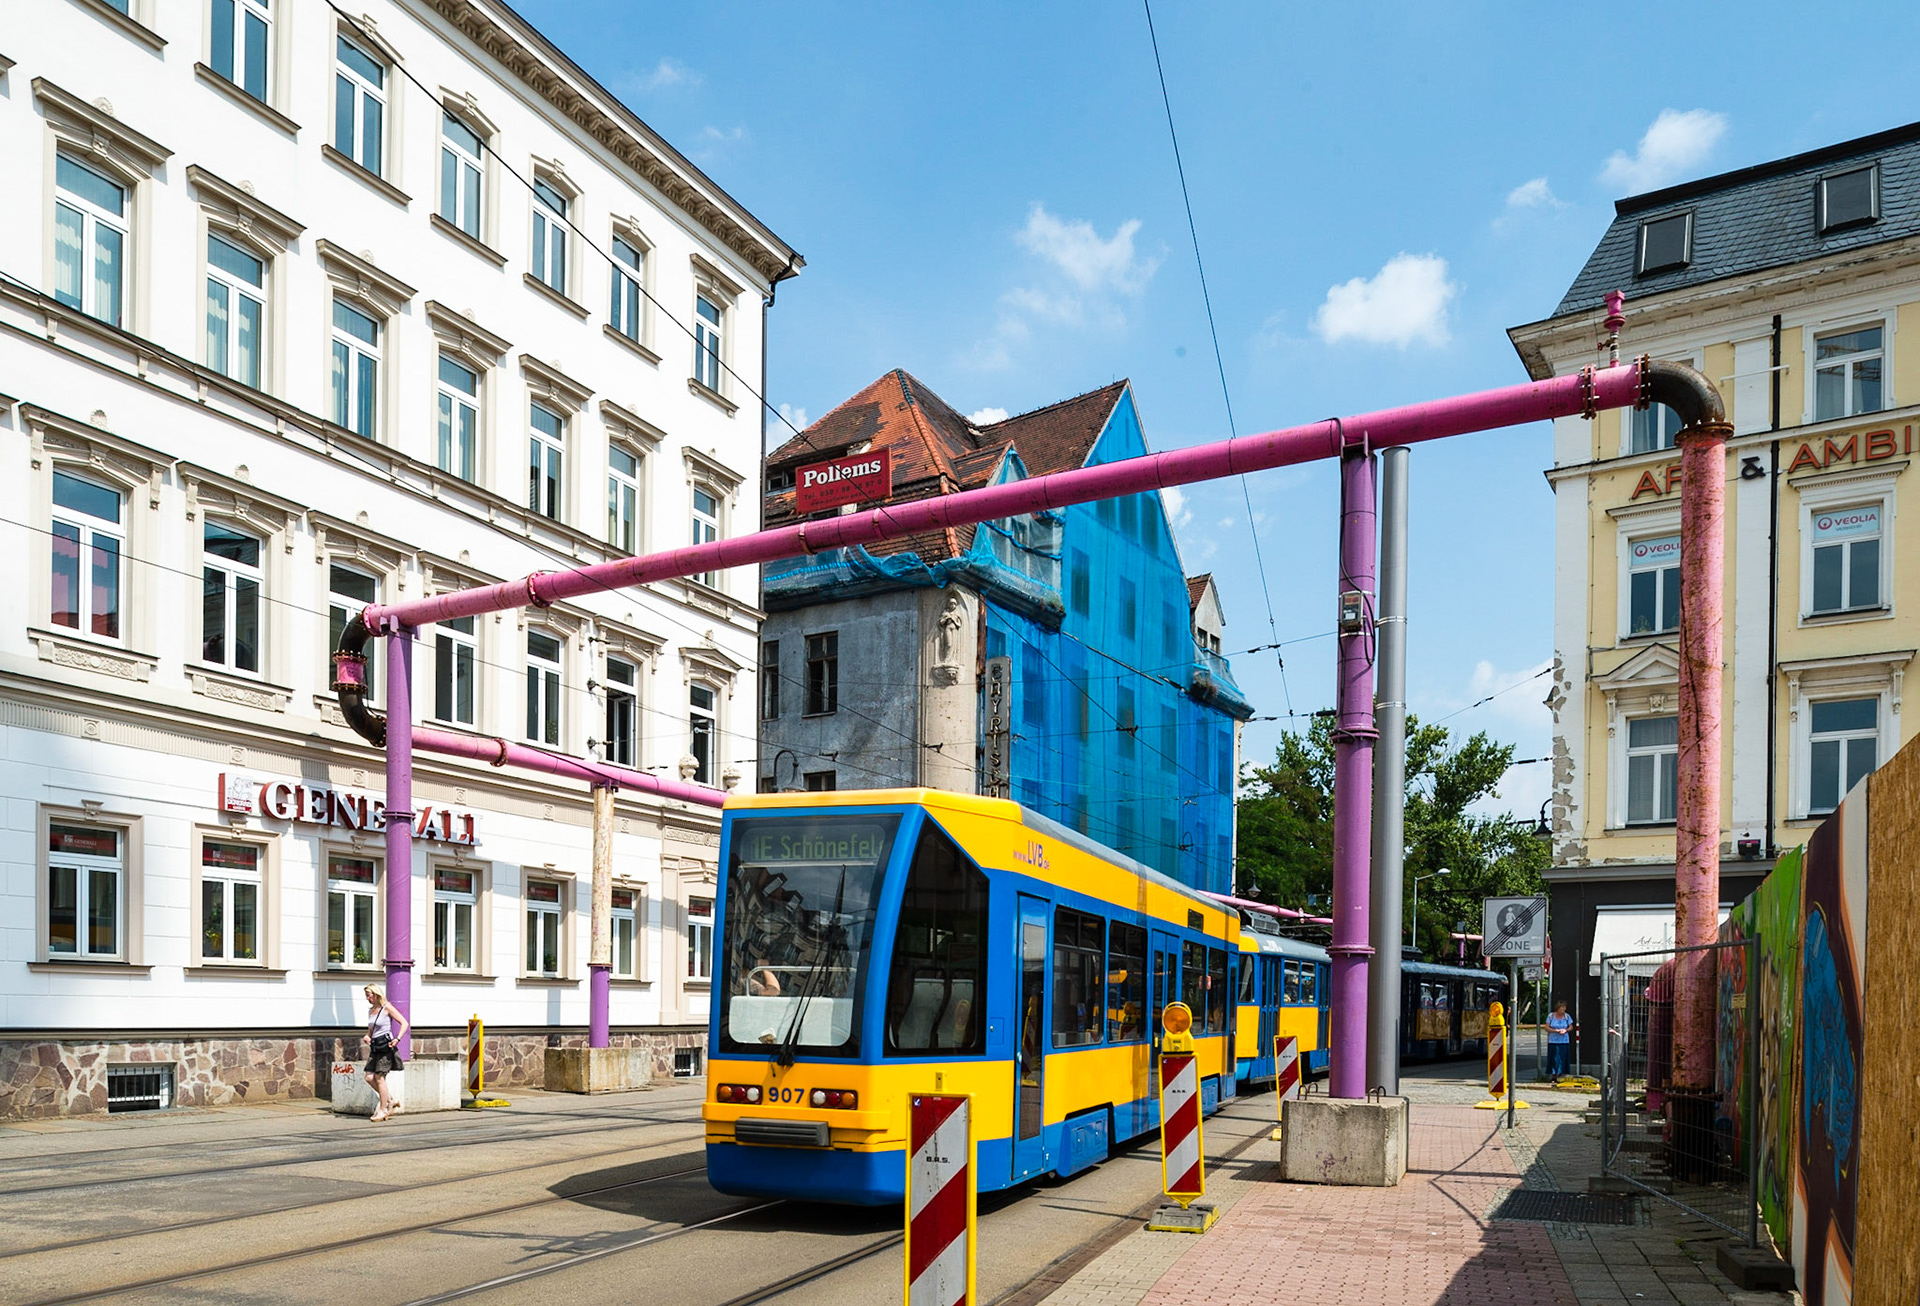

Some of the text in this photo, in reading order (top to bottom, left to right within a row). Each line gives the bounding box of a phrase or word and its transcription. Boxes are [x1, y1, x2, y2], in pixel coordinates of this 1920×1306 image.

[803, 460, 882, 488] Pollems
[1741, 456, 1766, 480] &
[1835, 513, 1877, 526] VEOLIA
[1650, 543, 1681, 553] VEOLI
[260, 780, 485, 847] GENEALI
[769, 1087, 805, 1104] 907
